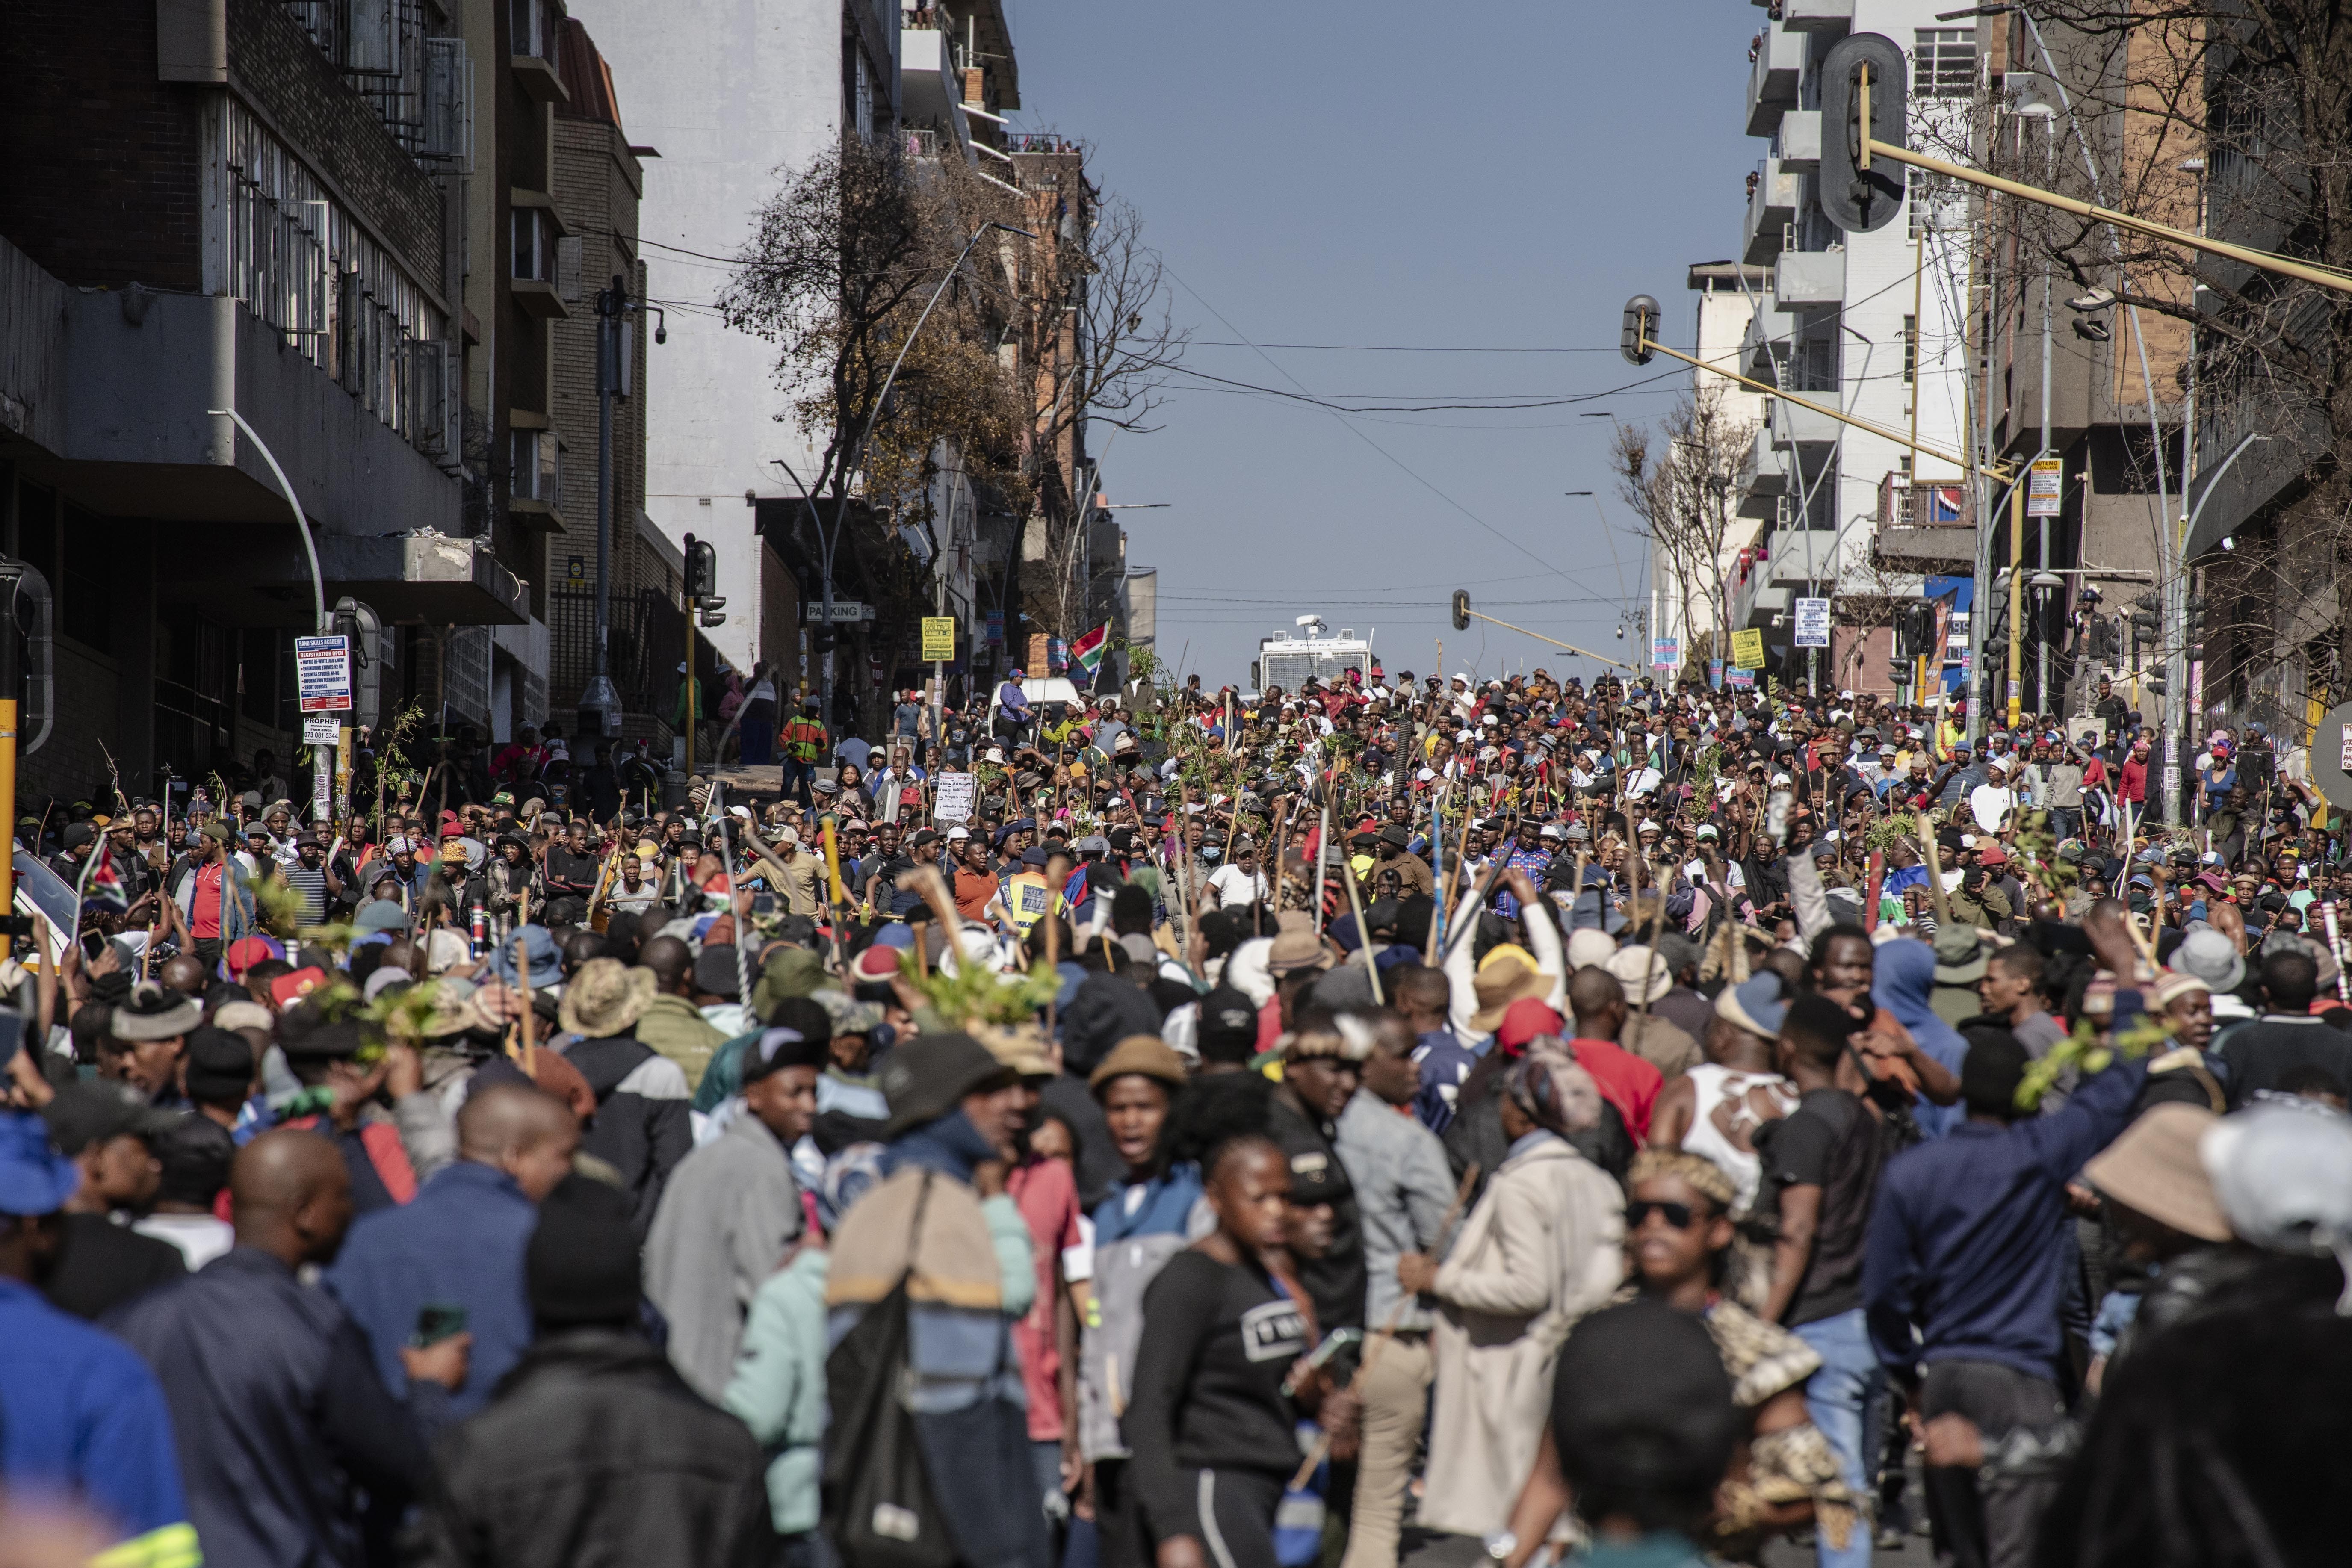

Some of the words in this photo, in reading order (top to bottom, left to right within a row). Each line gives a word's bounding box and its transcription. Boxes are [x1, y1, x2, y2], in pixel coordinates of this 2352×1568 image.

[809, 606, 857, 617] PAKING
[872, 669, 883, 680] TO
[1024, 888, 1047, 897] POLI
[1025, 899, 1047, 909] JMP
